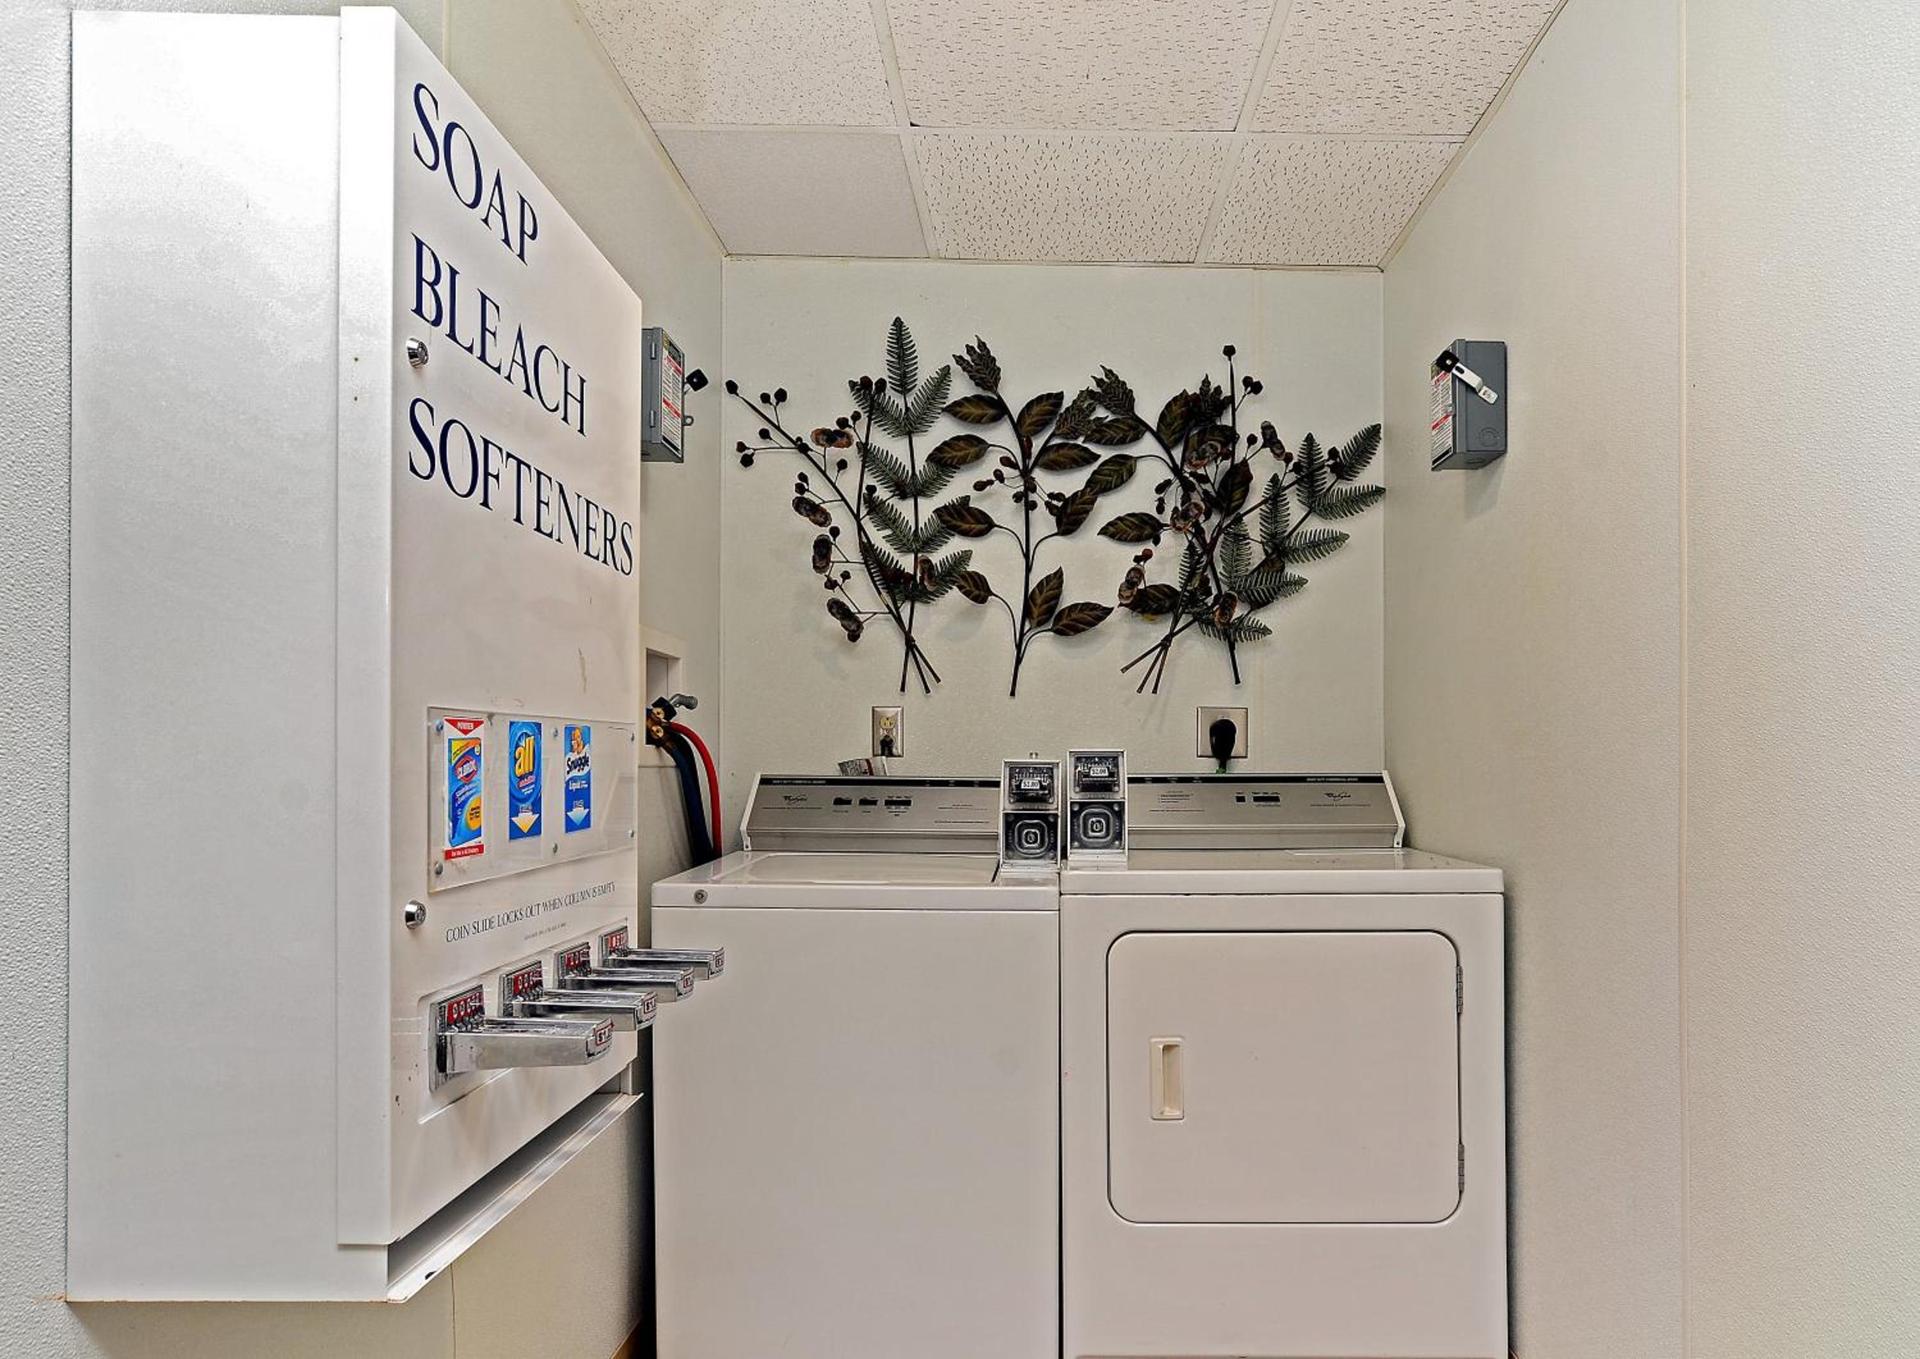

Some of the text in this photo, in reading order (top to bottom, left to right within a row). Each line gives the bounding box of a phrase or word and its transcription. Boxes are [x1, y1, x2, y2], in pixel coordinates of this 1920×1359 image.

[412, 82, 539, 267] SOAP
[410, 232, 587, 438] BLEACH
[408, 396, 635, 577] SOFTENERS
[515, 735, 536, 778] all
[446, 924, 470, 943] COIN
[471, 916, 496, 935] SLIDE
[497, 907, 524, 928] LOCKS
[525, 902, 541, 918] OUT
[542, 896, 563, 912] WHEN
